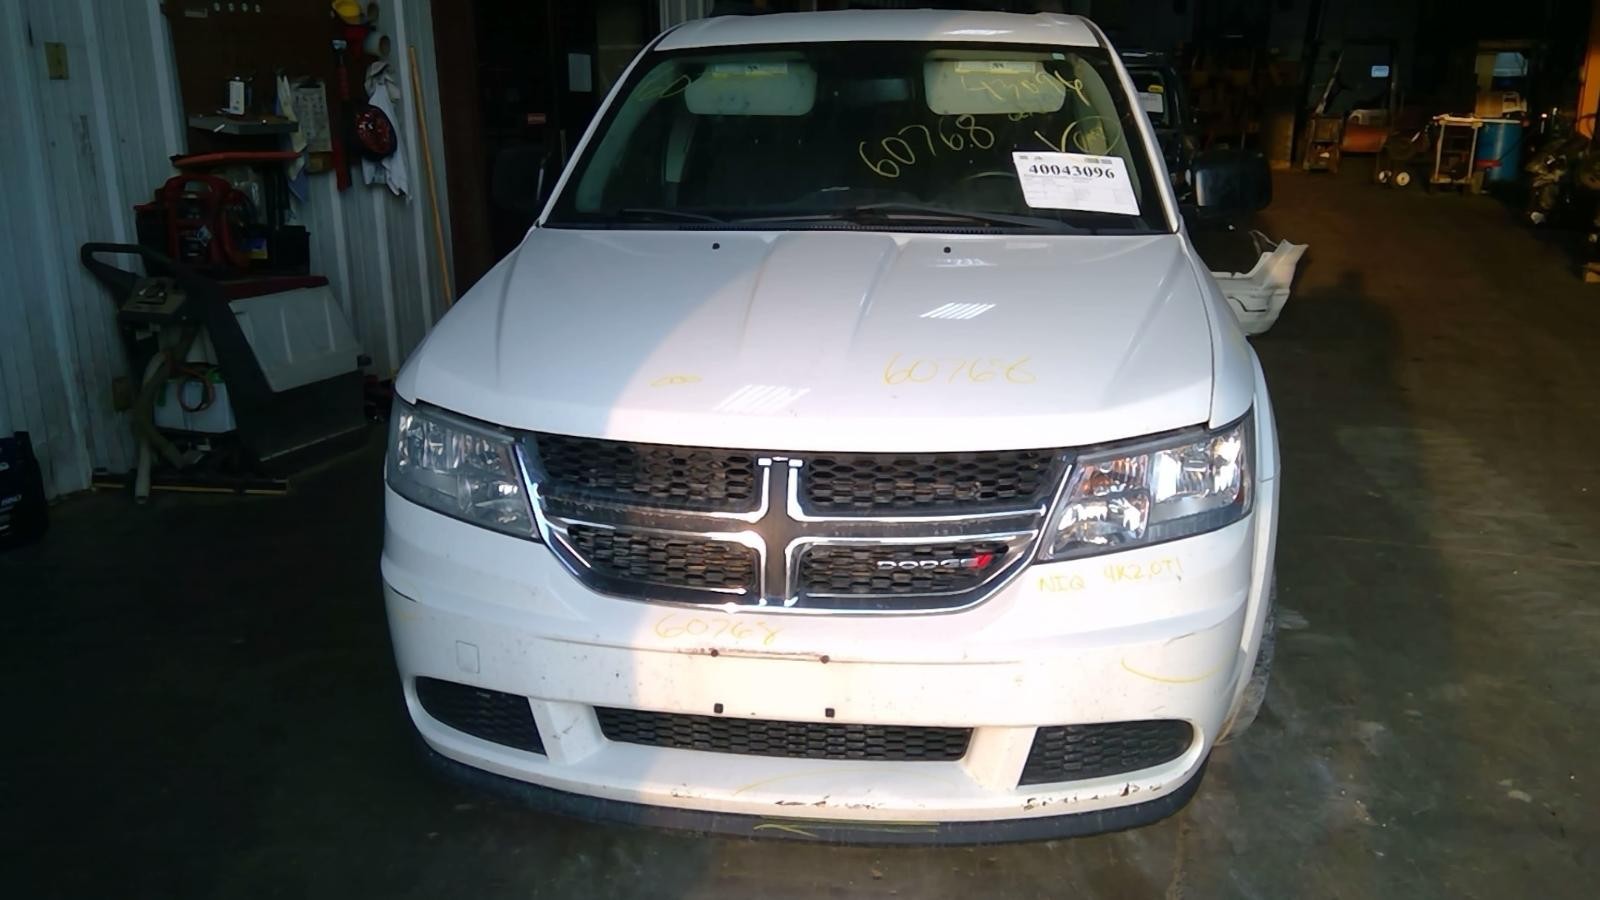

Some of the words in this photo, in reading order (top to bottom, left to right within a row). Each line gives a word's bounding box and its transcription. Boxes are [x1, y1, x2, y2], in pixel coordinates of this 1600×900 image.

[858, 113, 996, 179] 60768
[1028, 163, 1116, 180] 40043096
[876, 557, 978, 571] DODGE
[653, 612, 782, 647] 60768
